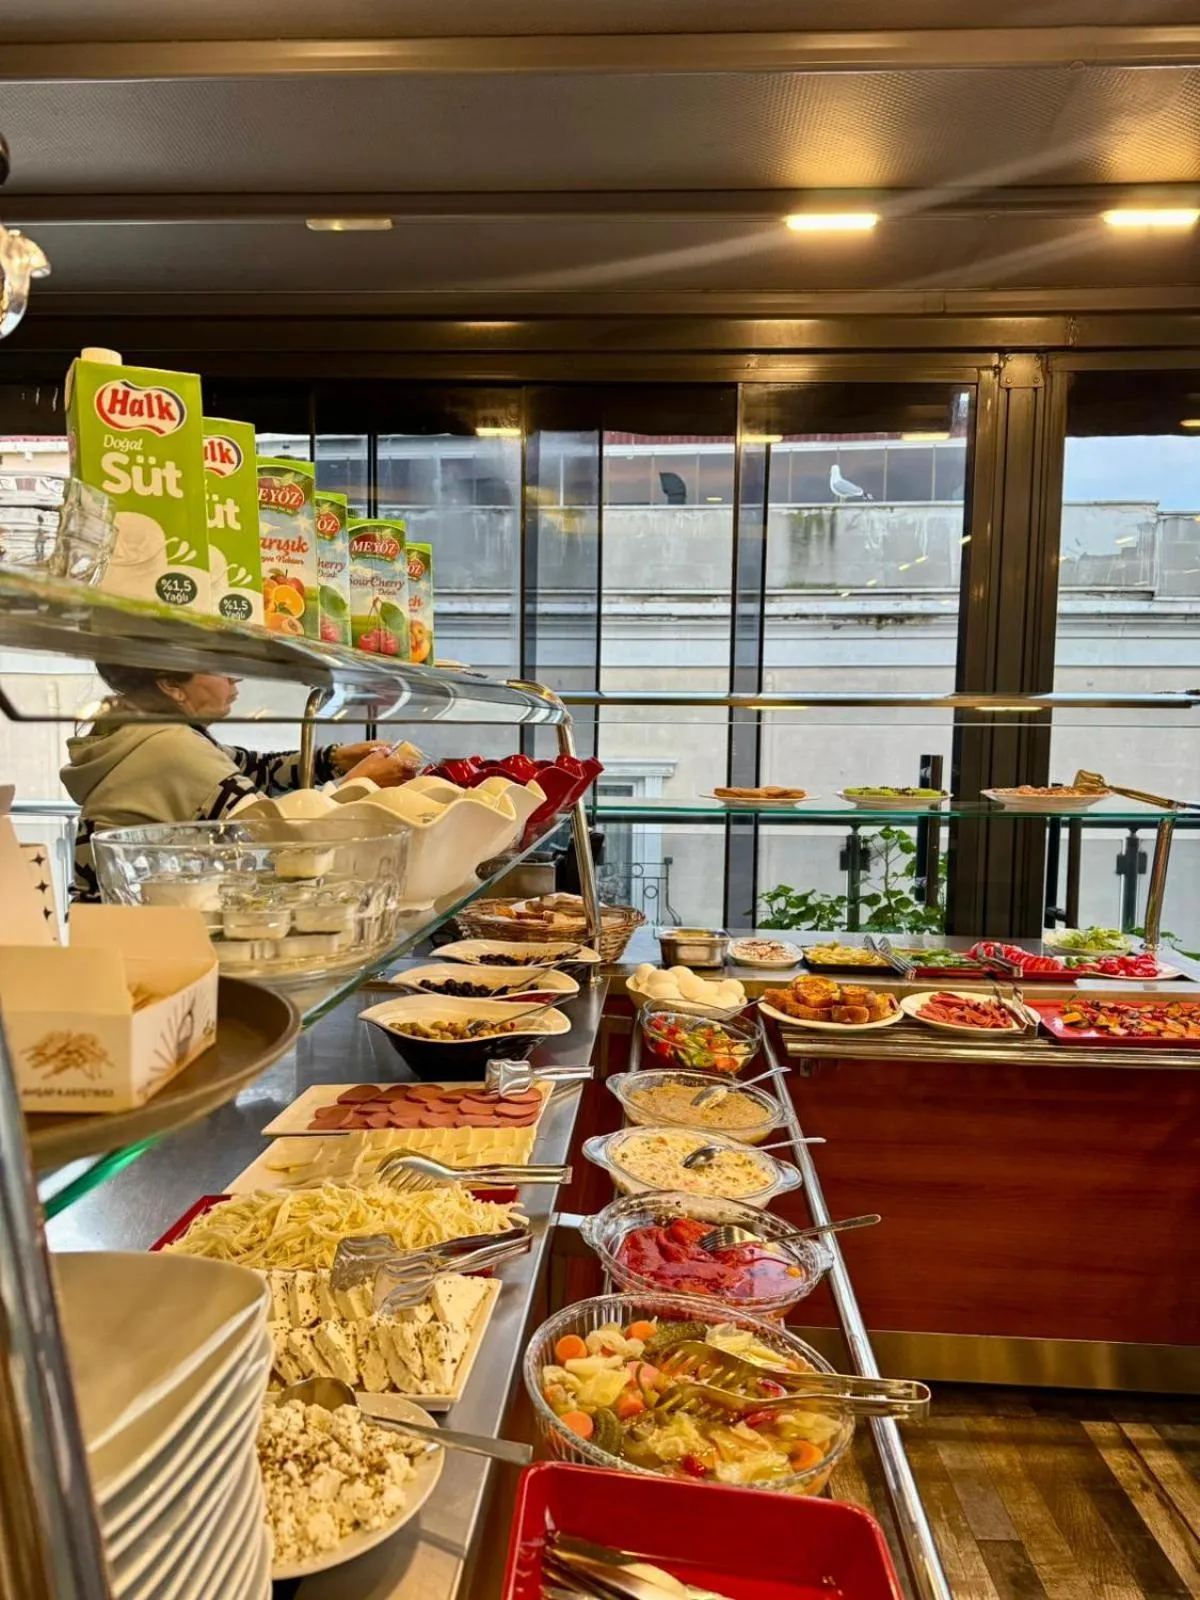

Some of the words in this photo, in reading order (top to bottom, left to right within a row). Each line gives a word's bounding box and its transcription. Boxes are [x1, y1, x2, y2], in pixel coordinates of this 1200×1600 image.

[107, 387, 177, 421] Halk
[103, 434, 143, 453] Doğal
[203, 439, 235, 465] lk
[100, 451, 184, 499] Süt
[259, 487, 301, 505] EYÖZ
[205, 493, 241, 531] üt
[260, 535, 308, 556] arışık
[351, 541, 397, 555] MEYÖZ
[161, 578, 192, 592] %1,5
[164, 592, 189, 604] Yağlı
[223, 599, 249, 611] %1,5
